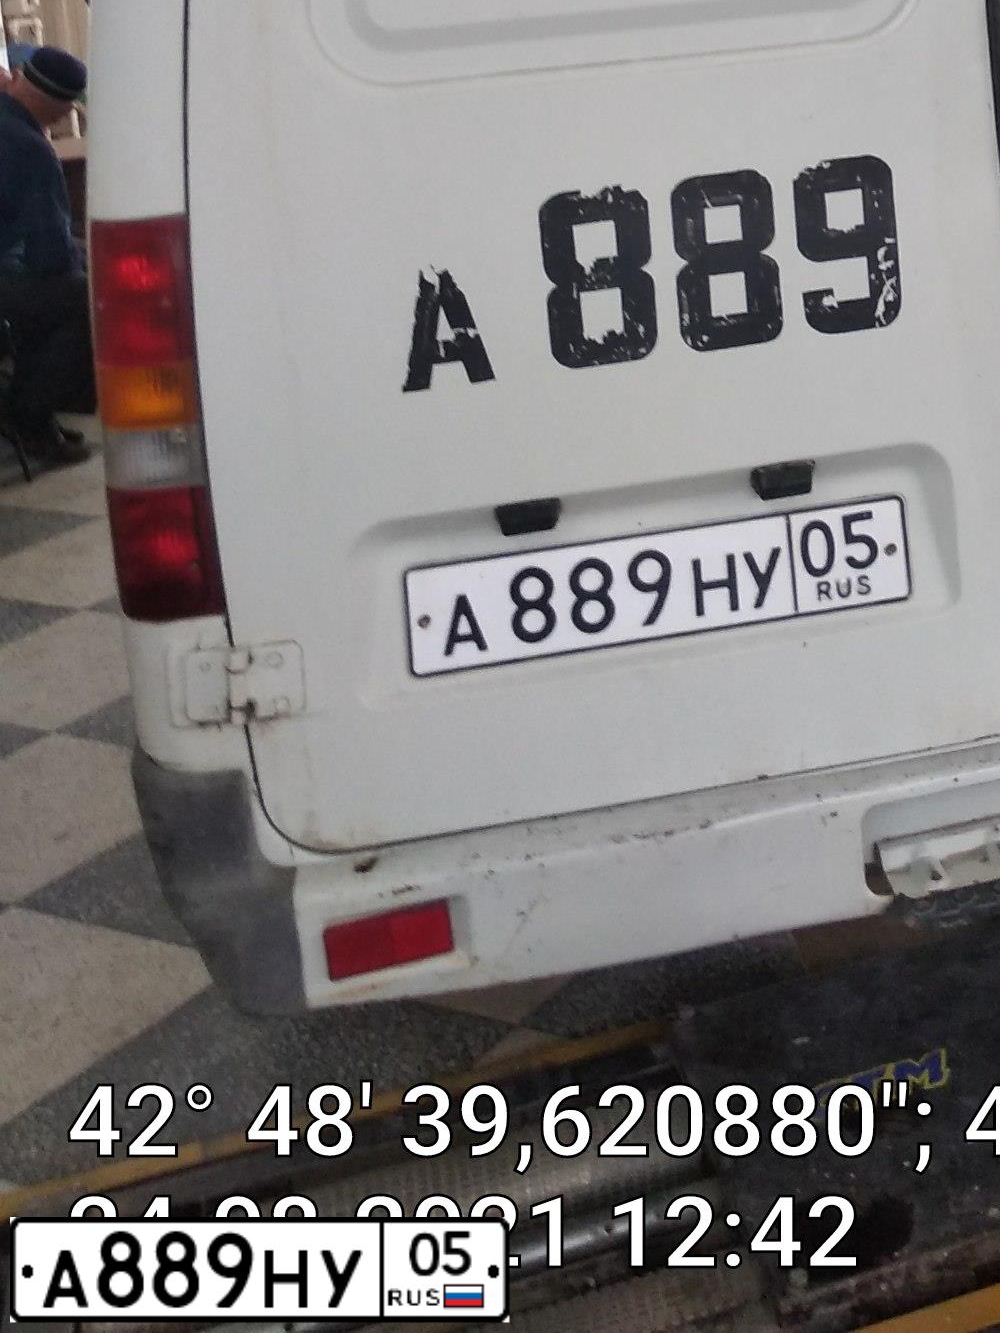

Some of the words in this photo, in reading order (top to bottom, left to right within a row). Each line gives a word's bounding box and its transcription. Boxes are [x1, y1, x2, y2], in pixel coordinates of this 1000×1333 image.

[538, 154, 902, 369] 889
[800, 511, 879, 578] 05
[817, 575, 872, 601] RUS
